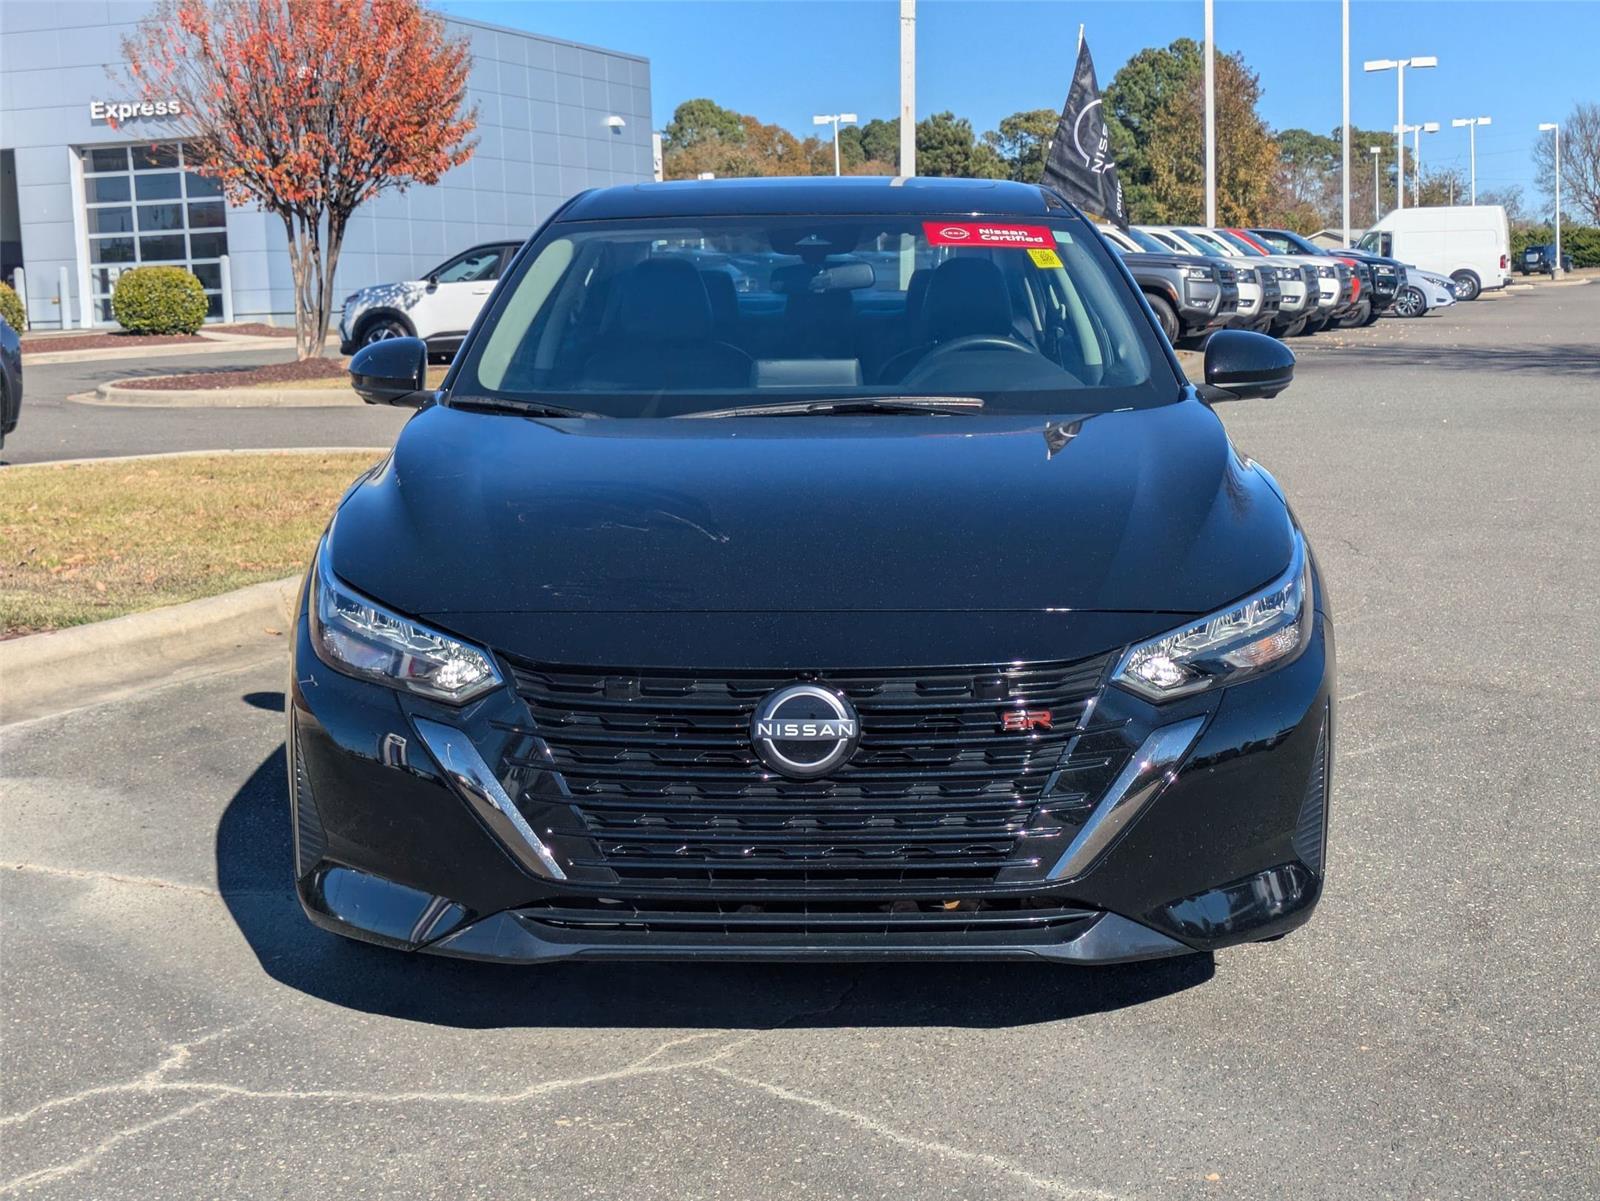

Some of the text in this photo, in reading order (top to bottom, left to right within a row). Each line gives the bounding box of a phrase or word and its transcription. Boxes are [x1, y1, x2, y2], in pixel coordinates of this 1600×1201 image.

[90, 101, 181, 122] Express
[978, 228, 1028, 237] Nissan
[980, 234, 1045, 243] Certified
[1003, 709, 1053, 731] SR
[757, 723, 853, 737] NISSAN
